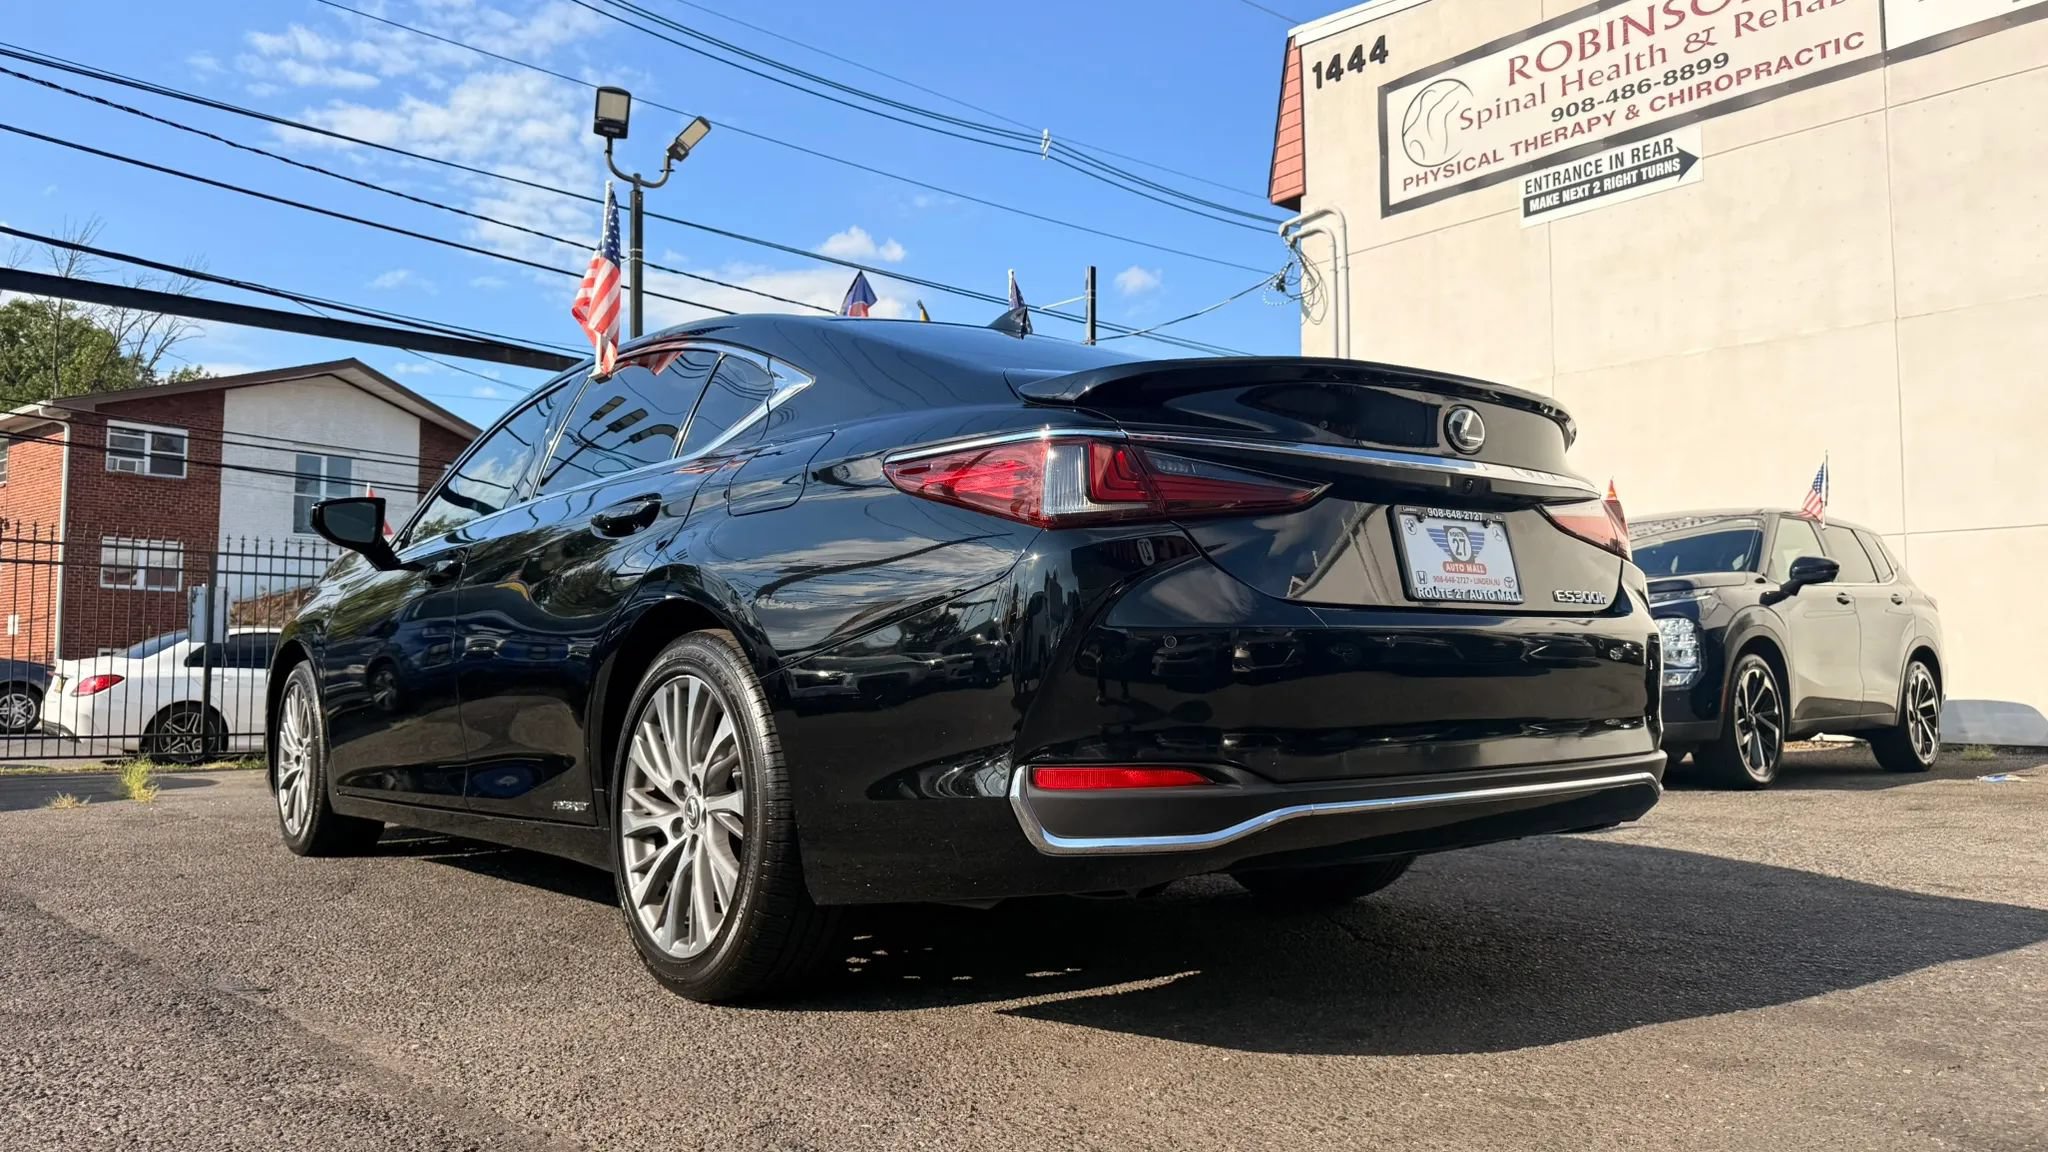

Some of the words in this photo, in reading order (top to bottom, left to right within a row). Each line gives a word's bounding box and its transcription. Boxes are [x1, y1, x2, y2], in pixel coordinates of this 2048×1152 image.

[1312, 34, 1388, 89] 1444
[1459, 82, 1545, 130] Spinal
[1560, 43, 1667, 97] Health
[1683, 26, 1717, 54] &
[1734, 0, 1846, 38] Reha
[1508, 0, 1750, 86] ROBINSO
[1403, 149, 1504, 191] PHYSICAL
[1510, 110, 1616, 156] THERAPY
[1624, 104, 1640, 121] &
[1649, 31, 1864, 112] CHIROPRACTIC
[1551, 52, 1729, 122] 908-486-8899
[1525, 158, 1603, 194] ENTRANCE
[1609, 153, 1625, 170] IN
[1631, 137, 1674, 164] REAR
[1529, 194, 1560, 212] MAKE
[1563, 184, 1590, 204] NEXT
[1593, 181, 1601, 194] 2
[1603, 171, 1638, 191] RIGHT
[1641, 158, 1681, 179] TURNS
[1427, 507, 1483, 521] 908-648-2727
[1445, 563, 1464, 572] AUTO
[1466, 564, 1485, 574] MALL
[1452, 537, 1467, 556] 27
[1418, 587, 1453, 599] ROUTE
[1455, 588, 1466, 599] 27
[1470, 589, 1494, 600] AUTO
[1496, 590, 1523, 601] MALL
[1553, 590, 1607, 604] ES300h
